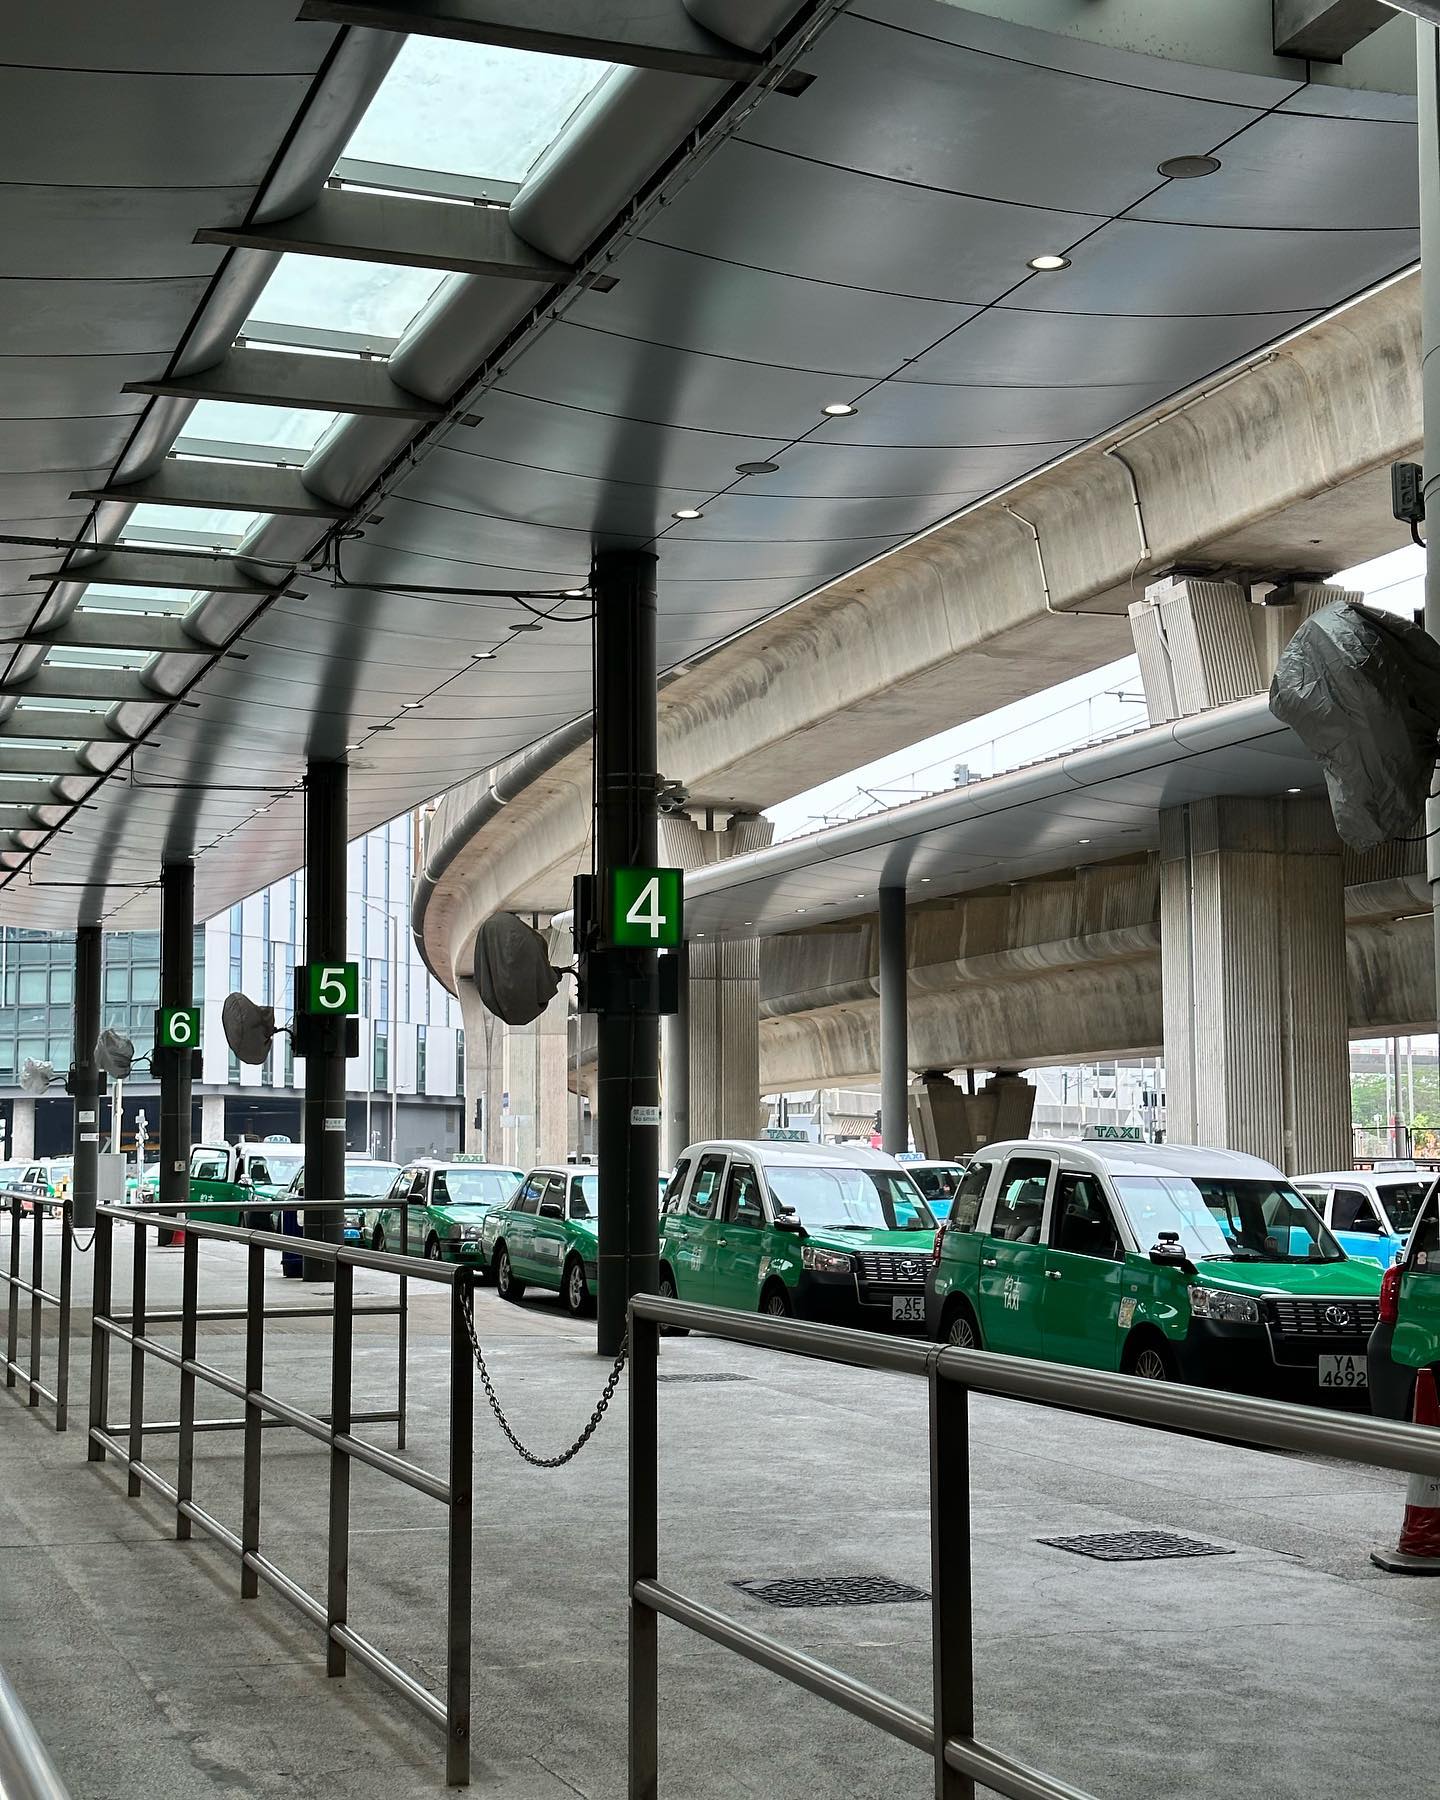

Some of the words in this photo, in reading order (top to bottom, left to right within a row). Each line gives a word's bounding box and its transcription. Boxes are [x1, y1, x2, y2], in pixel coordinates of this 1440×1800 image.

[626, 877, 667, 938] 4
[319, 967, 347, 1009] 5
[169, 1011, 191, 1043] 6
[767, 1129, 807, 1140] TAXI
[1094, 1125, 1140, 1139] TAXI
[455, 1154, 484, 1162] TAXI
[1004, 1274, 1022, 1293] 的士
[904, 1297, 922, 1309] XF
[1003, 1291, 1020, 1311] TAXI
[1334, 1355, 1355, 1371] YA
[1322, 1370, 1367, 1387] 4692
